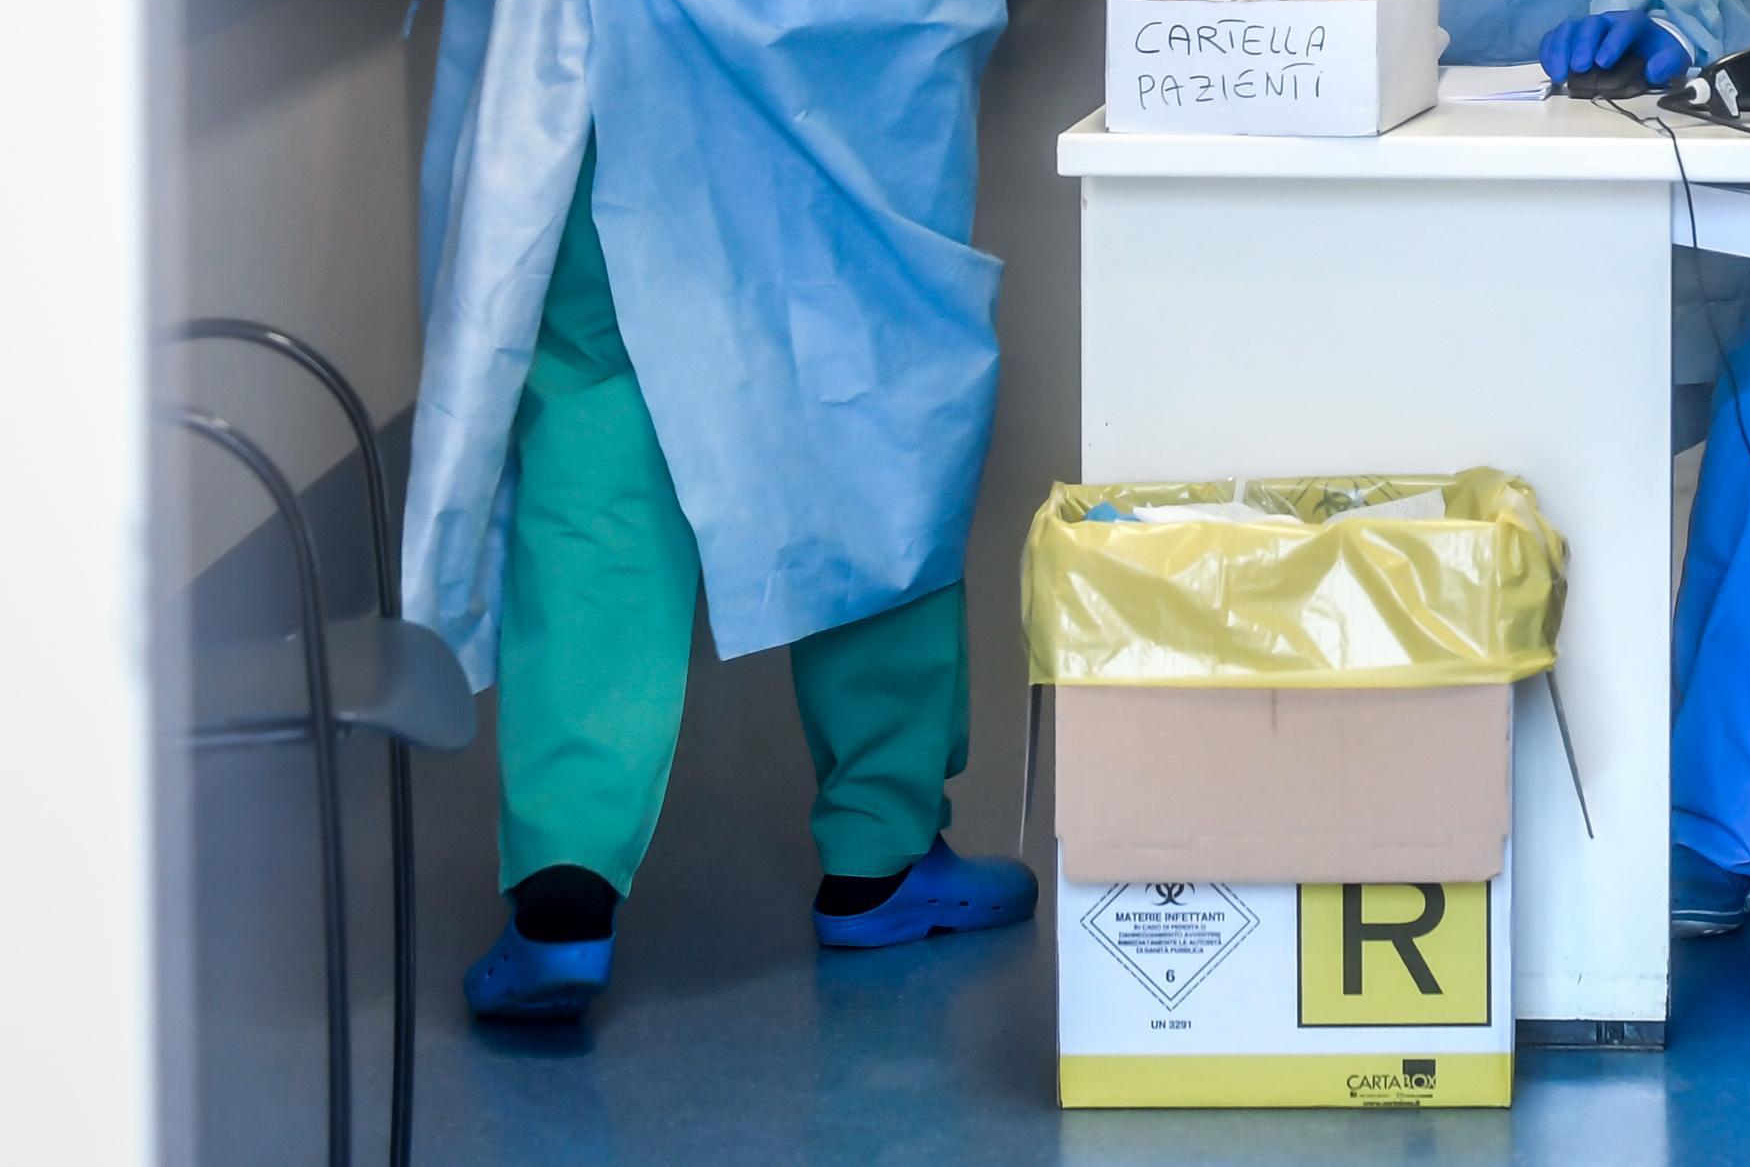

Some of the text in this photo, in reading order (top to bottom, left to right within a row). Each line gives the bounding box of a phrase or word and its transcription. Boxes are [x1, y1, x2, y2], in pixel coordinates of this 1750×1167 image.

[1136, 19, 1326, 57] CARTELLA
[1115, 912, 1225, 922] MATERIE INFETTANTI
[1342, 883, 1447, 995] R
[1165, 969, 1176, 983] 6
[1151, 1020, 1192, 1029] UN 3291
[1347, 1074, 1436, 1090] CARTABOX
